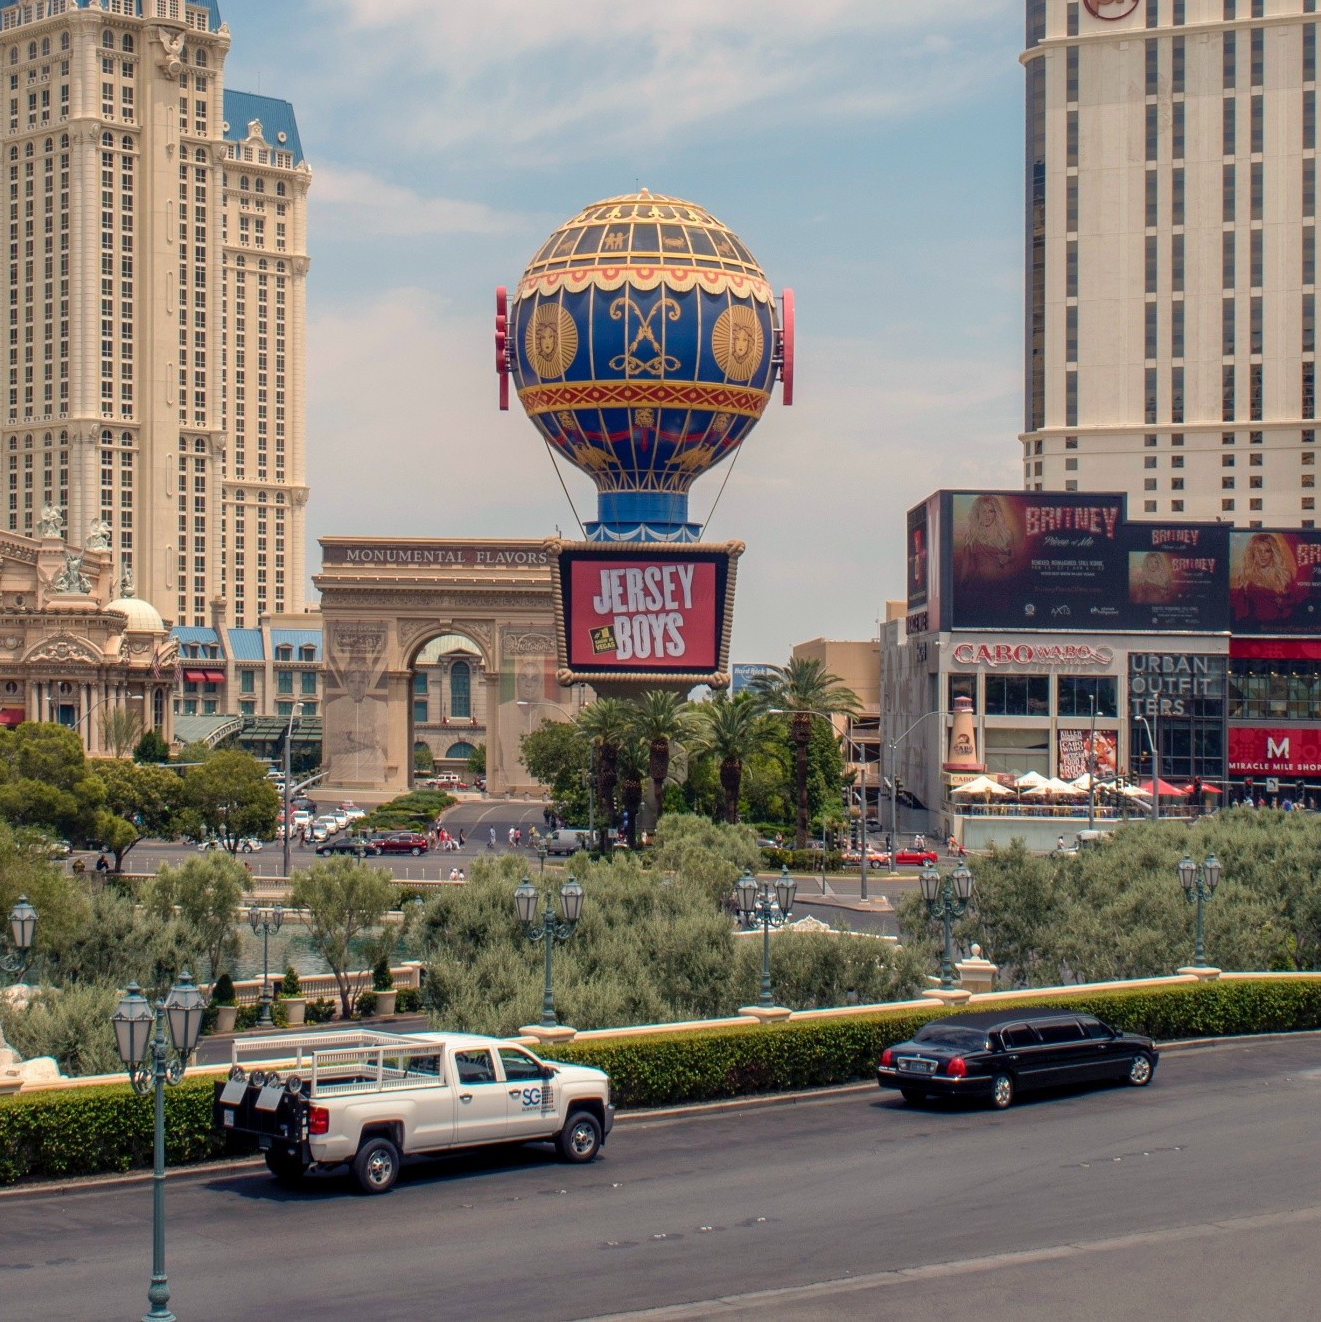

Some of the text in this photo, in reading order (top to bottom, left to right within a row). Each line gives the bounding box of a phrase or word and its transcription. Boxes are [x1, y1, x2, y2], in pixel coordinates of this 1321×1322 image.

[1025, 507, 1119, 539] BRITNEY
[1152, 529, 1199, 546] BRITNEY
[346, 549, 547, 564] MONUMENTAL FLAVORS
[593, 564, 694, 614] JERSEY
[614, 612, 685, 660] BOYS
[954, 643, 1092, 667] CABO WABO
[1131, 655, 1208, 674] URBAN
[1131, 677, 1211, 695] OUTFIT
[1131, 699, 1185, 716] TERS
[953, 744, 973, 754] CABO
[1267, 737, 1290, 758] M
[1229, 762, 1269, 770] MIRACLE
[523, 1088, 541, 1106] SG
